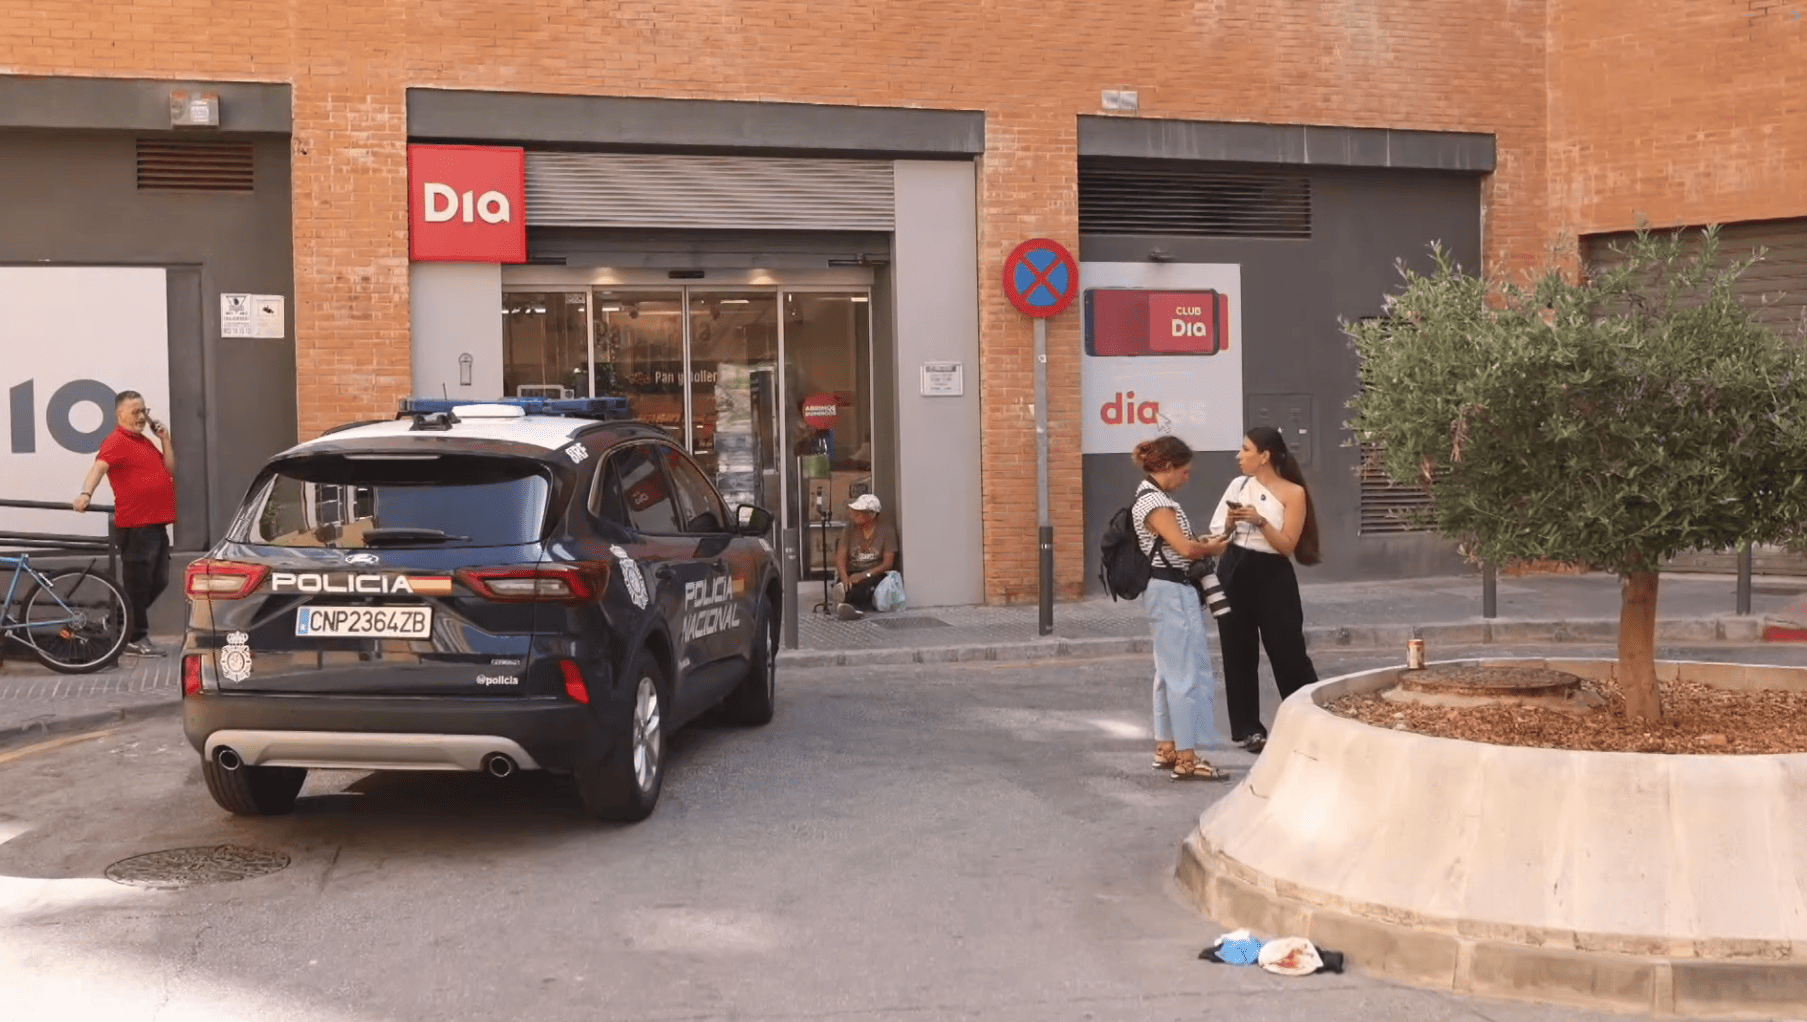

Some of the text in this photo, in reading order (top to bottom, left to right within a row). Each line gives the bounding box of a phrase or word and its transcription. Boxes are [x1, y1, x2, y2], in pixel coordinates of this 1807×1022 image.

[1175, 306, 1202, 316] CLUB
[655, 371, 674, 384] Pan
[690, 369, 719, 382] oller
[272, 573, 414, 594] POLICIA
[310, 610, 426, 633] CNP2364ZB
[681, 602, 741, 643] NACIONAL
[476, 674, 519, 686] @policia
